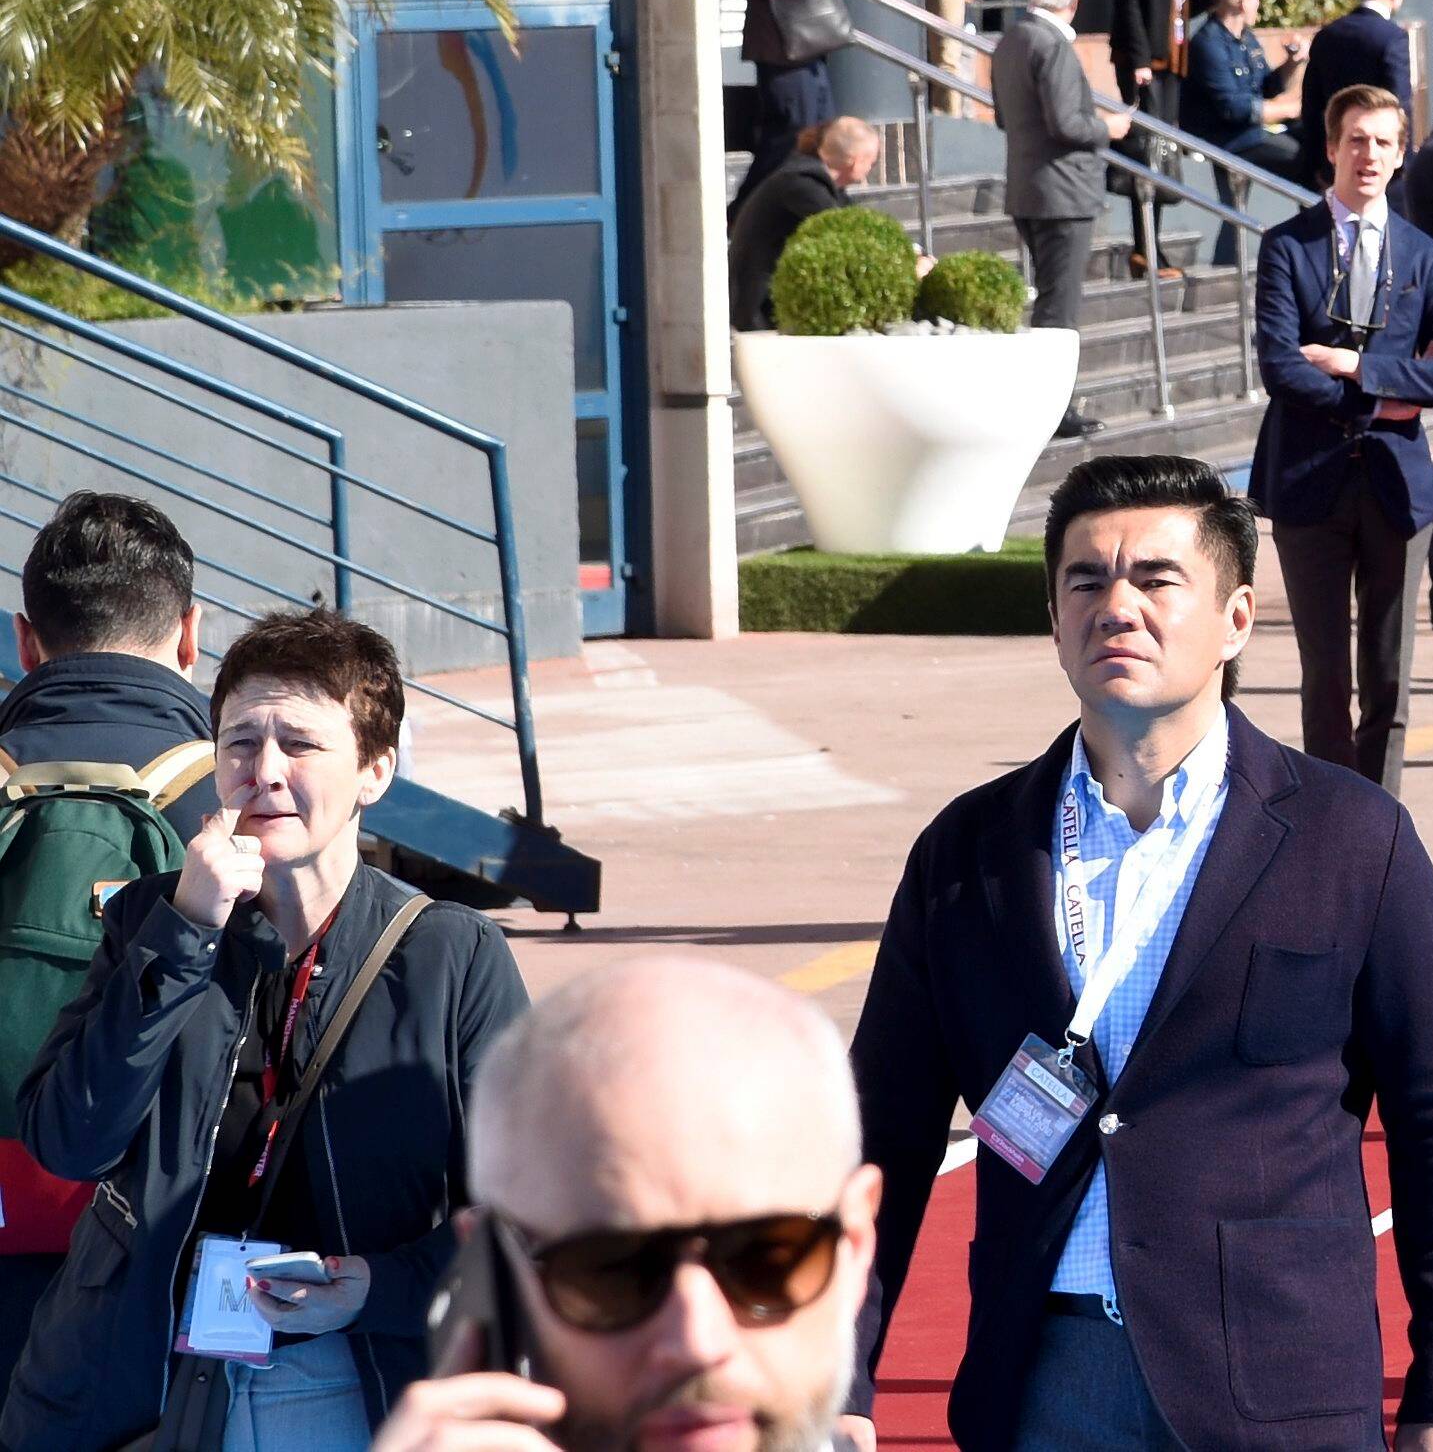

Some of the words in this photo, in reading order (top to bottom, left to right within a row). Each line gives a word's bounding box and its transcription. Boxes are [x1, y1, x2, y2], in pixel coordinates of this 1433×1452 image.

[1061, 790, 1078, 868] CATELLA
[1066, 883, 1088, 968] CATELLA
[1030, 1066, 1069, 1100] CATELLA
